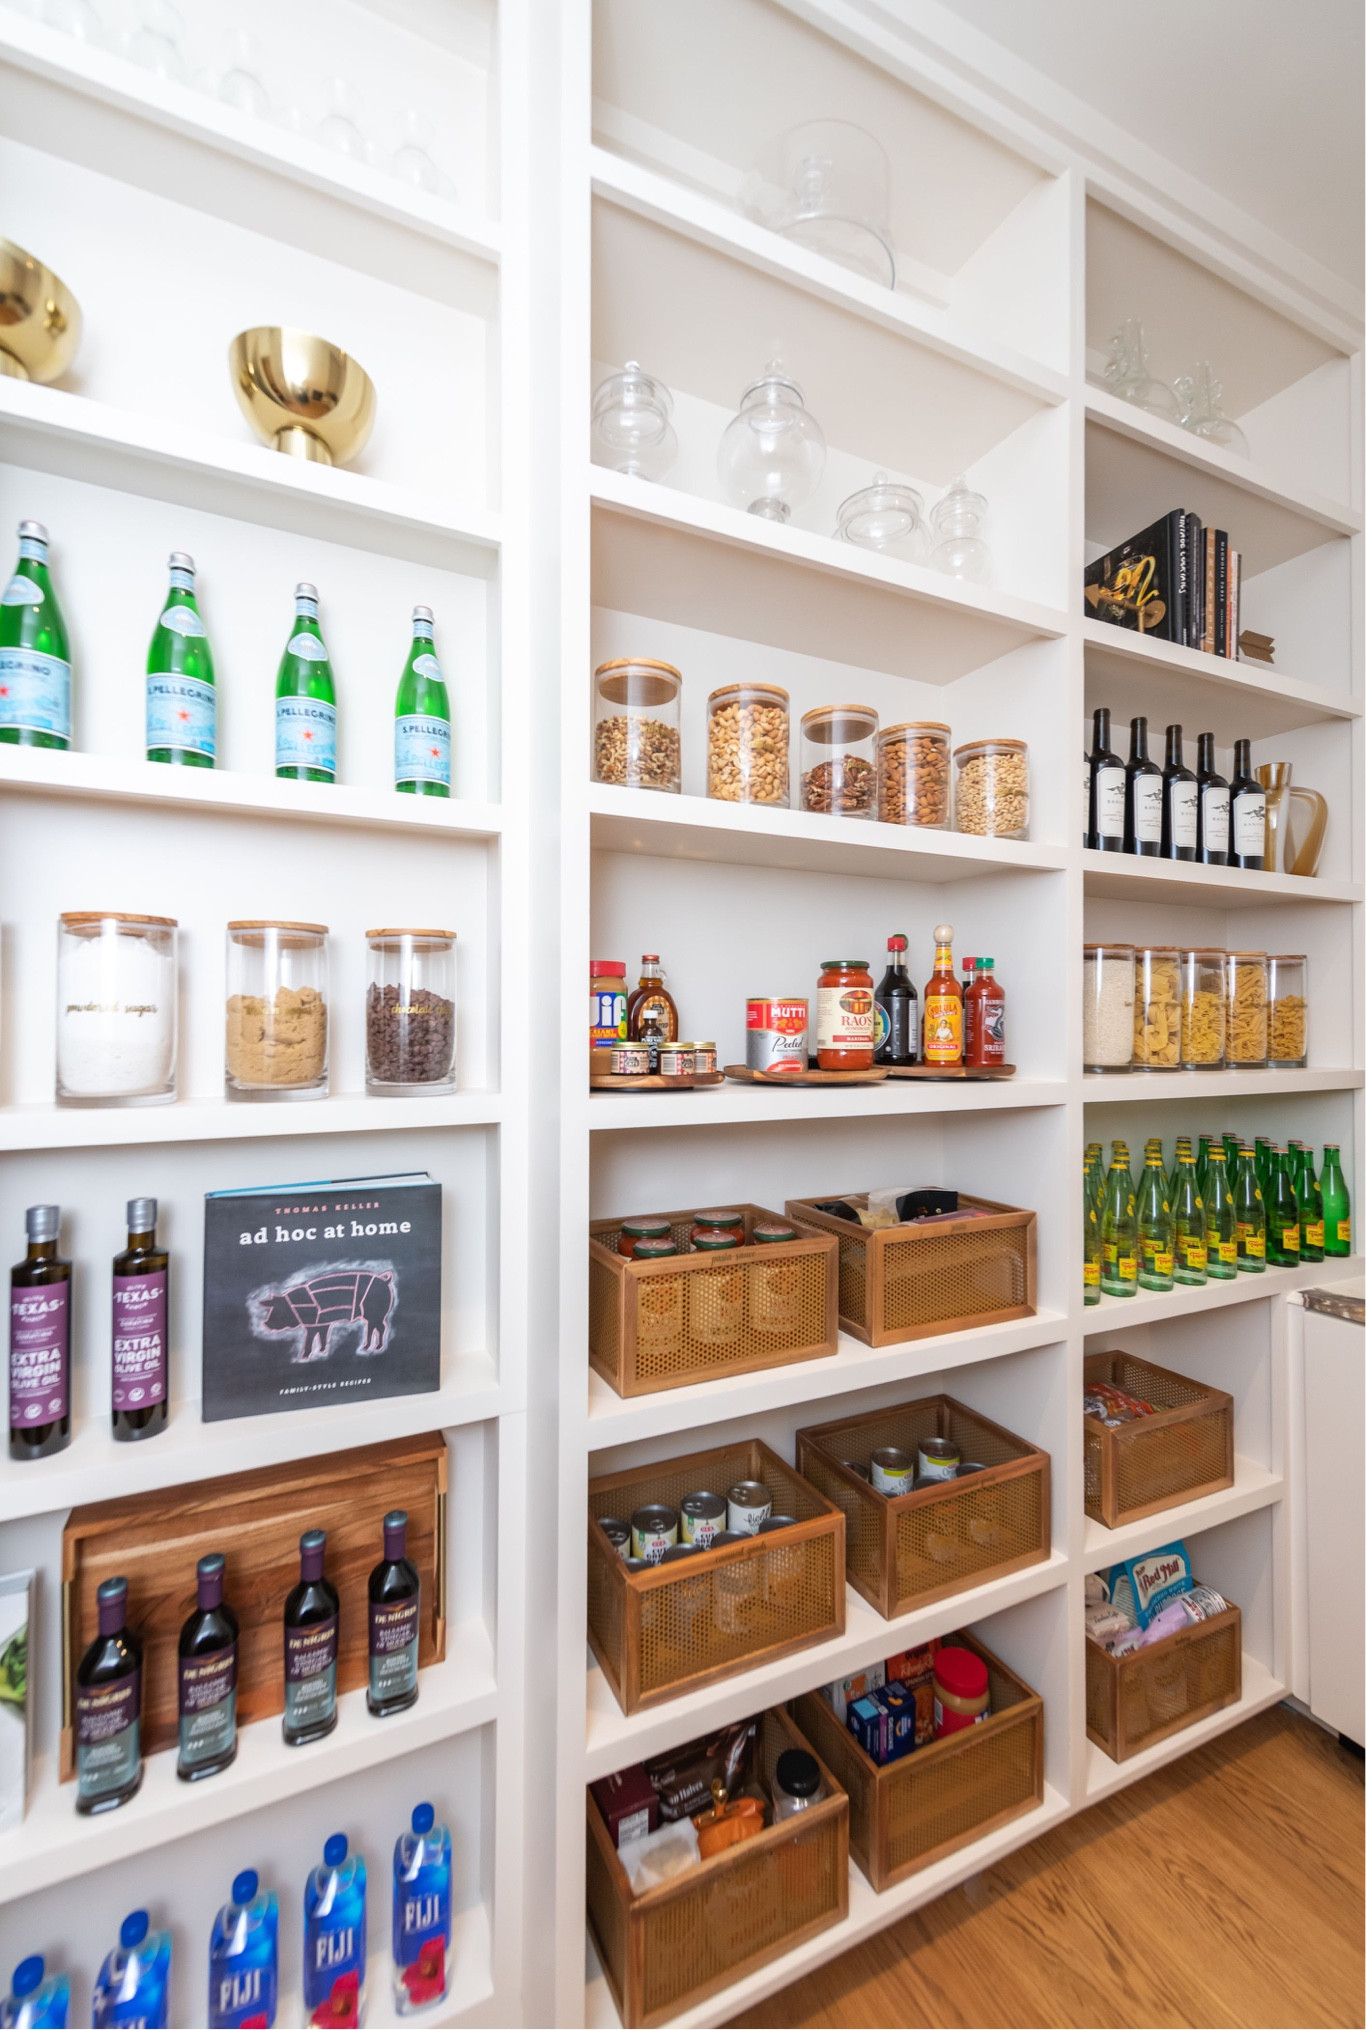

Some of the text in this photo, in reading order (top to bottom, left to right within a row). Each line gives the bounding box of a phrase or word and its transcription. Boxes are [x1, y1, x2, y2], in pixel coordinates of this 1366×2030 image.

[771, 1007, 805, 1018] MUTTI
[842, 1016, 872, 1026] RAO'S
[772, 1036, 803, 1052] Peeled
[275, 1202, 379, 1215] THOMAS KELLER
[239, 1221, 411, 1245] ad hoc at home
[115, 1288, 160, 1303] TEXAS
[13, 1299, 60, 1316] TEXAS
[114, 1335, 161, 1350] EXTRA
[114, 1346, 161, 1363] VIRGIN
[144, 1359, 161, 1370] OIL
[1140, 1559, 1180, 1591] Red Mill
[405, 1904, 440, 1933] FIJI
[316, 1928, 354, 1967] FIJI
[219, 1970, 261, 2012] FIJI
